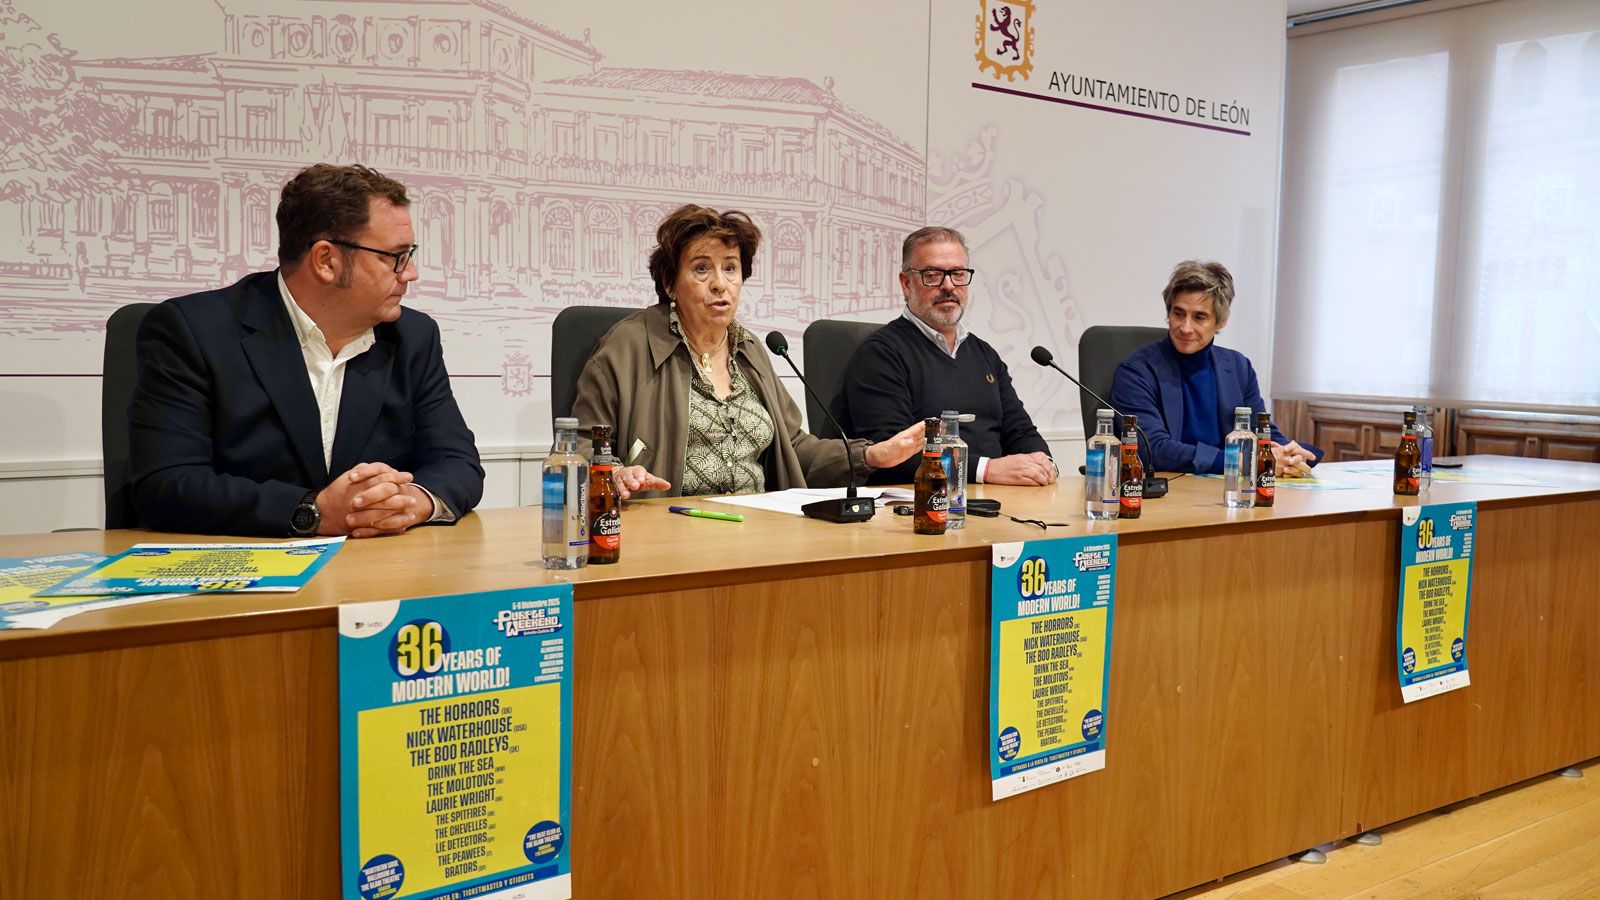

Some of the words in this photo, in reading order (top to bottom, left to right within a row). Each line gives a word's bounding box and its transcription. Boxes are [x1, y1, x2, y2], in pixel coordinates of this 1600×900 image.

[1049, 71, 1179, 113] AYUNTAMIENTO
[1186, 97, 1206, 118] DE
[1212, 100, 1250, 126] LEÓN
[1418, 518, 1433, 548] 36
[1022, 558, 1046, 597] 36
[1044, 580, 1066, 595] YEARS
[1068, 579, 1077, 592] OF
[1018, 598, 1050, 616] MODERN
[1051, 594, 1080, 612] WORLD!
[498, 609, 545, 630] PURPLE
[506, 616, 558, 637] WEEKEND
[1031, 621, 1042, 634] THE
[1044, 617, 1074, 632] HORRORS
[397, 622, 443, 676] 36
[442, 649, 483, 672] YEARS
[486, 646, 502, 666] OF
[1024, 638, 1038, 651] NICK
[1040, 630, 1080, 647] WATERHOUSE
[1026, 651, 1037, 664] THE
[1038, 649, 1050, 662] BOO
[1051, 644, 1078, 660] RADLEYS
[1034, 662, 1048, 675] DRINK
[1050, 660, 1059, 672] THE
[1060, 660, 1068, 670] SEA
[392, 674, 453, 703] MODERN
[456, 667, 510, 694] WORLD!
[1032, 687, 1048, 700] LAURIE
[1050, 683, 1069, 696] WRIGHT
[1033, 675, 1042, 687] THE
[420, 707, 441, 726] THE
[444, 699, 500, 722] HORRORS
[406, 729, 434, 748] NICK
[437, 716, 512, 743] WATERHOUSE
[410, 748, 431, 767] THE
[434, 744, 457, 762] BOO
[460, 735, 509, 758] RADLEYS
[428, 764, 456, 780] DRINK
[458, 760, 474, 775] THE
[477, 757, 494, 771] SEA
[428, 782, 444, 797] THE
[446, 772, 494, 793] MOLOTOVS
[426, 795, 458, 814] LAURIE
[460, 788, 495, 807] WRIGHT
[436, 813, 449, 825] THE
[451, 806, 486, 822] SPITFIRES
[435, 827, 448, 839] THE
[450, 819, 487, 836] CHEVELLES
[436, 841, 448, 853] LIE
[448, 832, 487, 850] DETECTORS
[438, 854, 450, 866] THE
[452, 846, 486, 862] PEAWEES
[445, 861, 478, 878] BRATORS
[463, 881, 502, 897] TICKETMASTER
